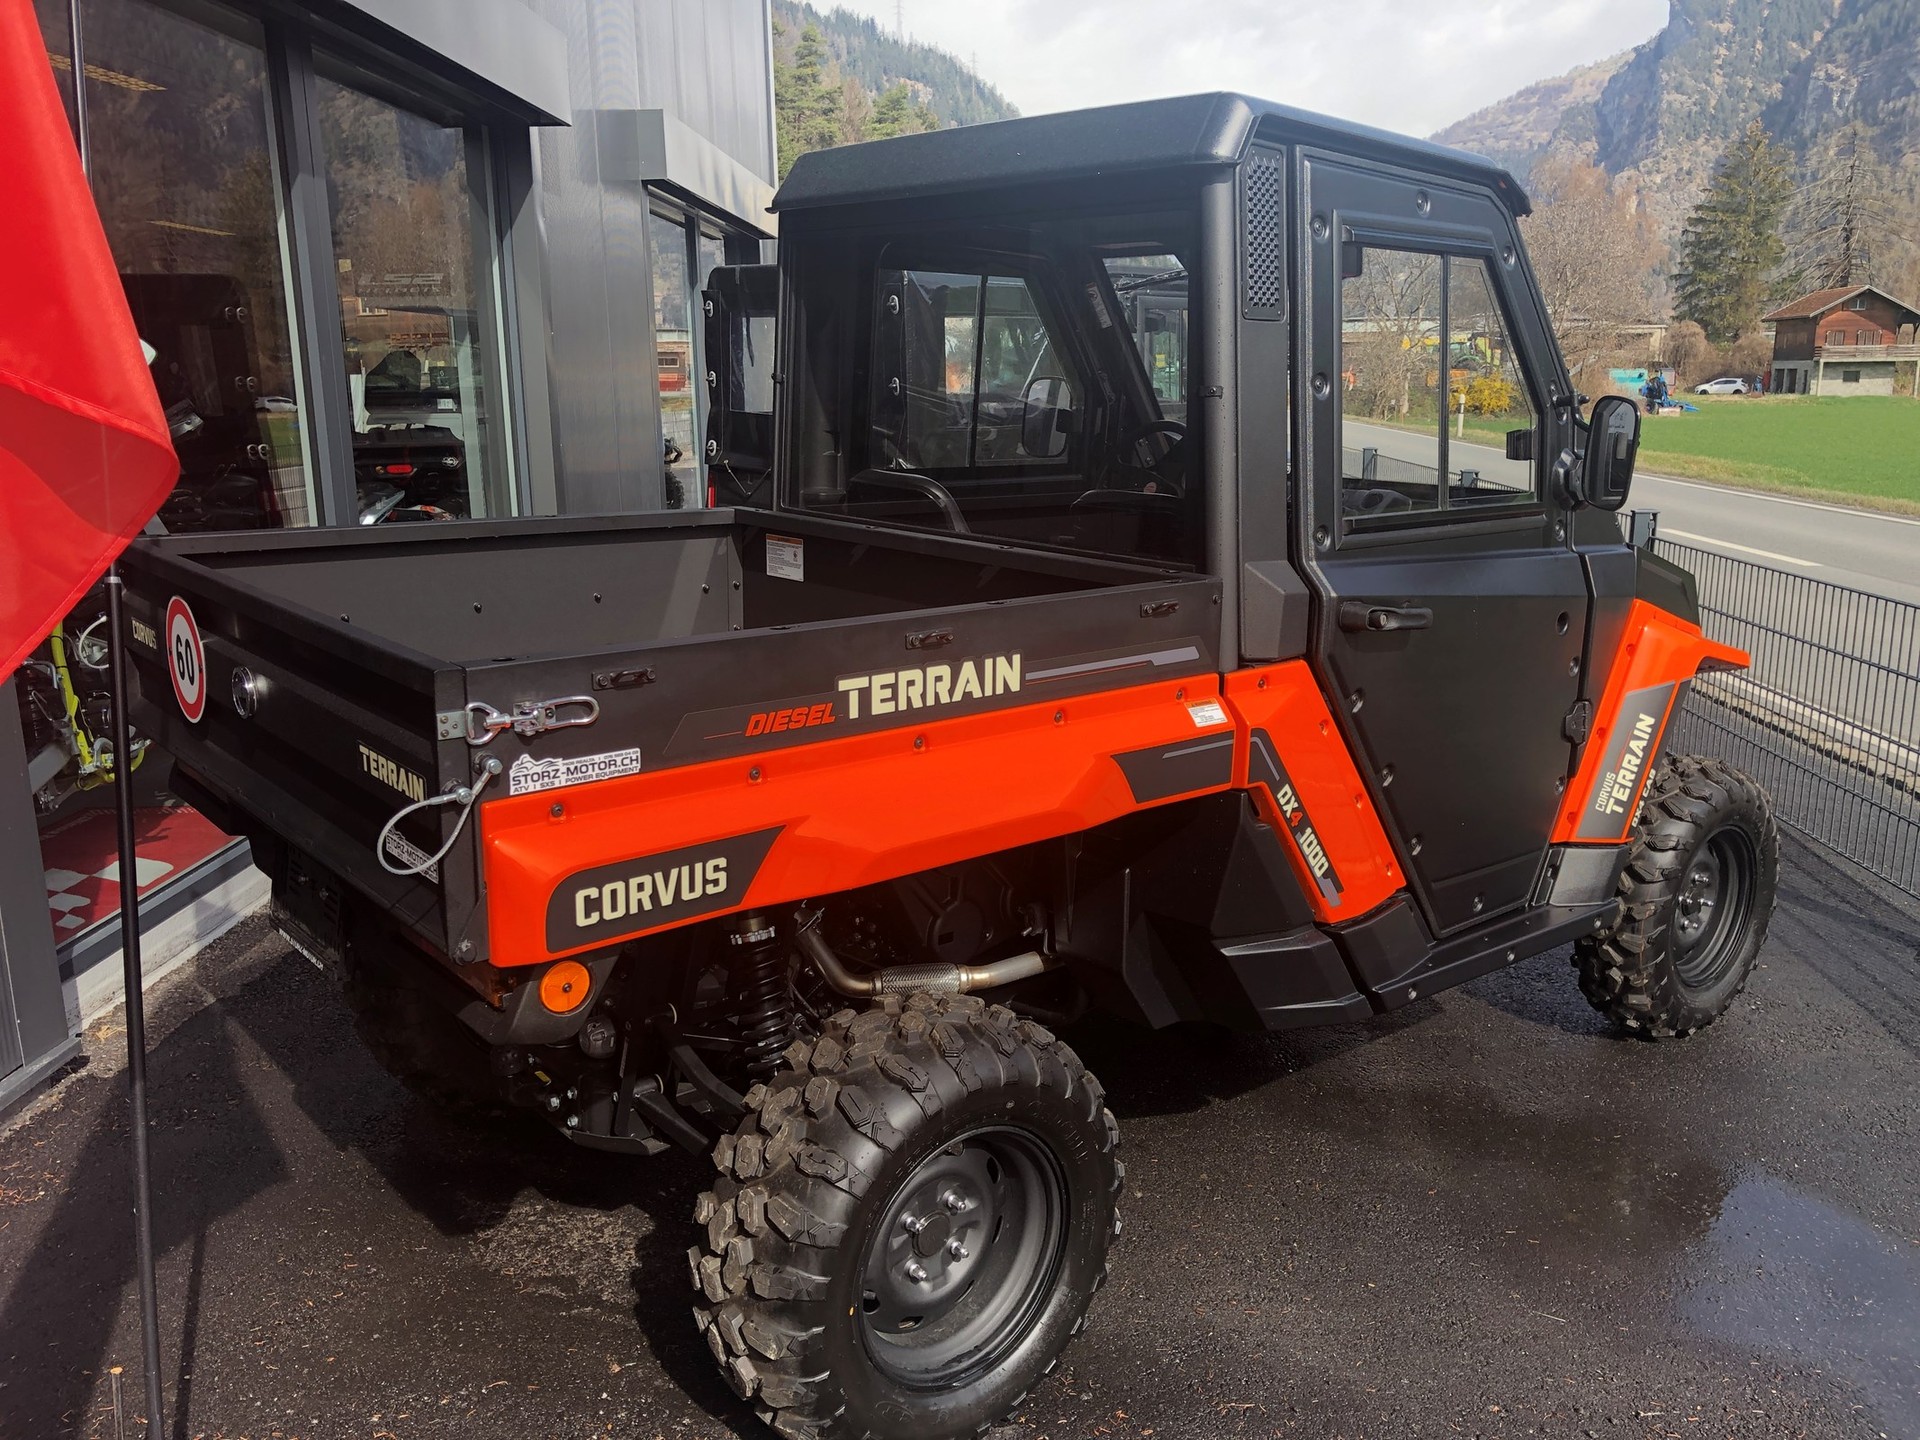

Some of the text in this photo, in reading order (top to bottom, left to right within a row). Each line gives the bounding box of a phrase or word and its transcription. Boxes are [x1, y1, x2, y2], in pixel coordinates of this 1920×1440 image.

[131, 619, 157, 650] CORVUS
[176, 633, 195, 686] 60
[745, 654, 1021, 737] DIESEL TERRAIN
[359, 744, 425, 802] TERRAIN
[512, 755, 639, 786] STORZ-MOTOR.CH
[513, 766, 639, 794] ATV SXS POWER EQUIPMENT
[1595, 771, 1616, 812] CORVUS
[1605, 713, 1656, 815] TERRAIN
[1276, 783, 1329, 878] DX4 1000
[575, 857, 728, 927] CORVUS
